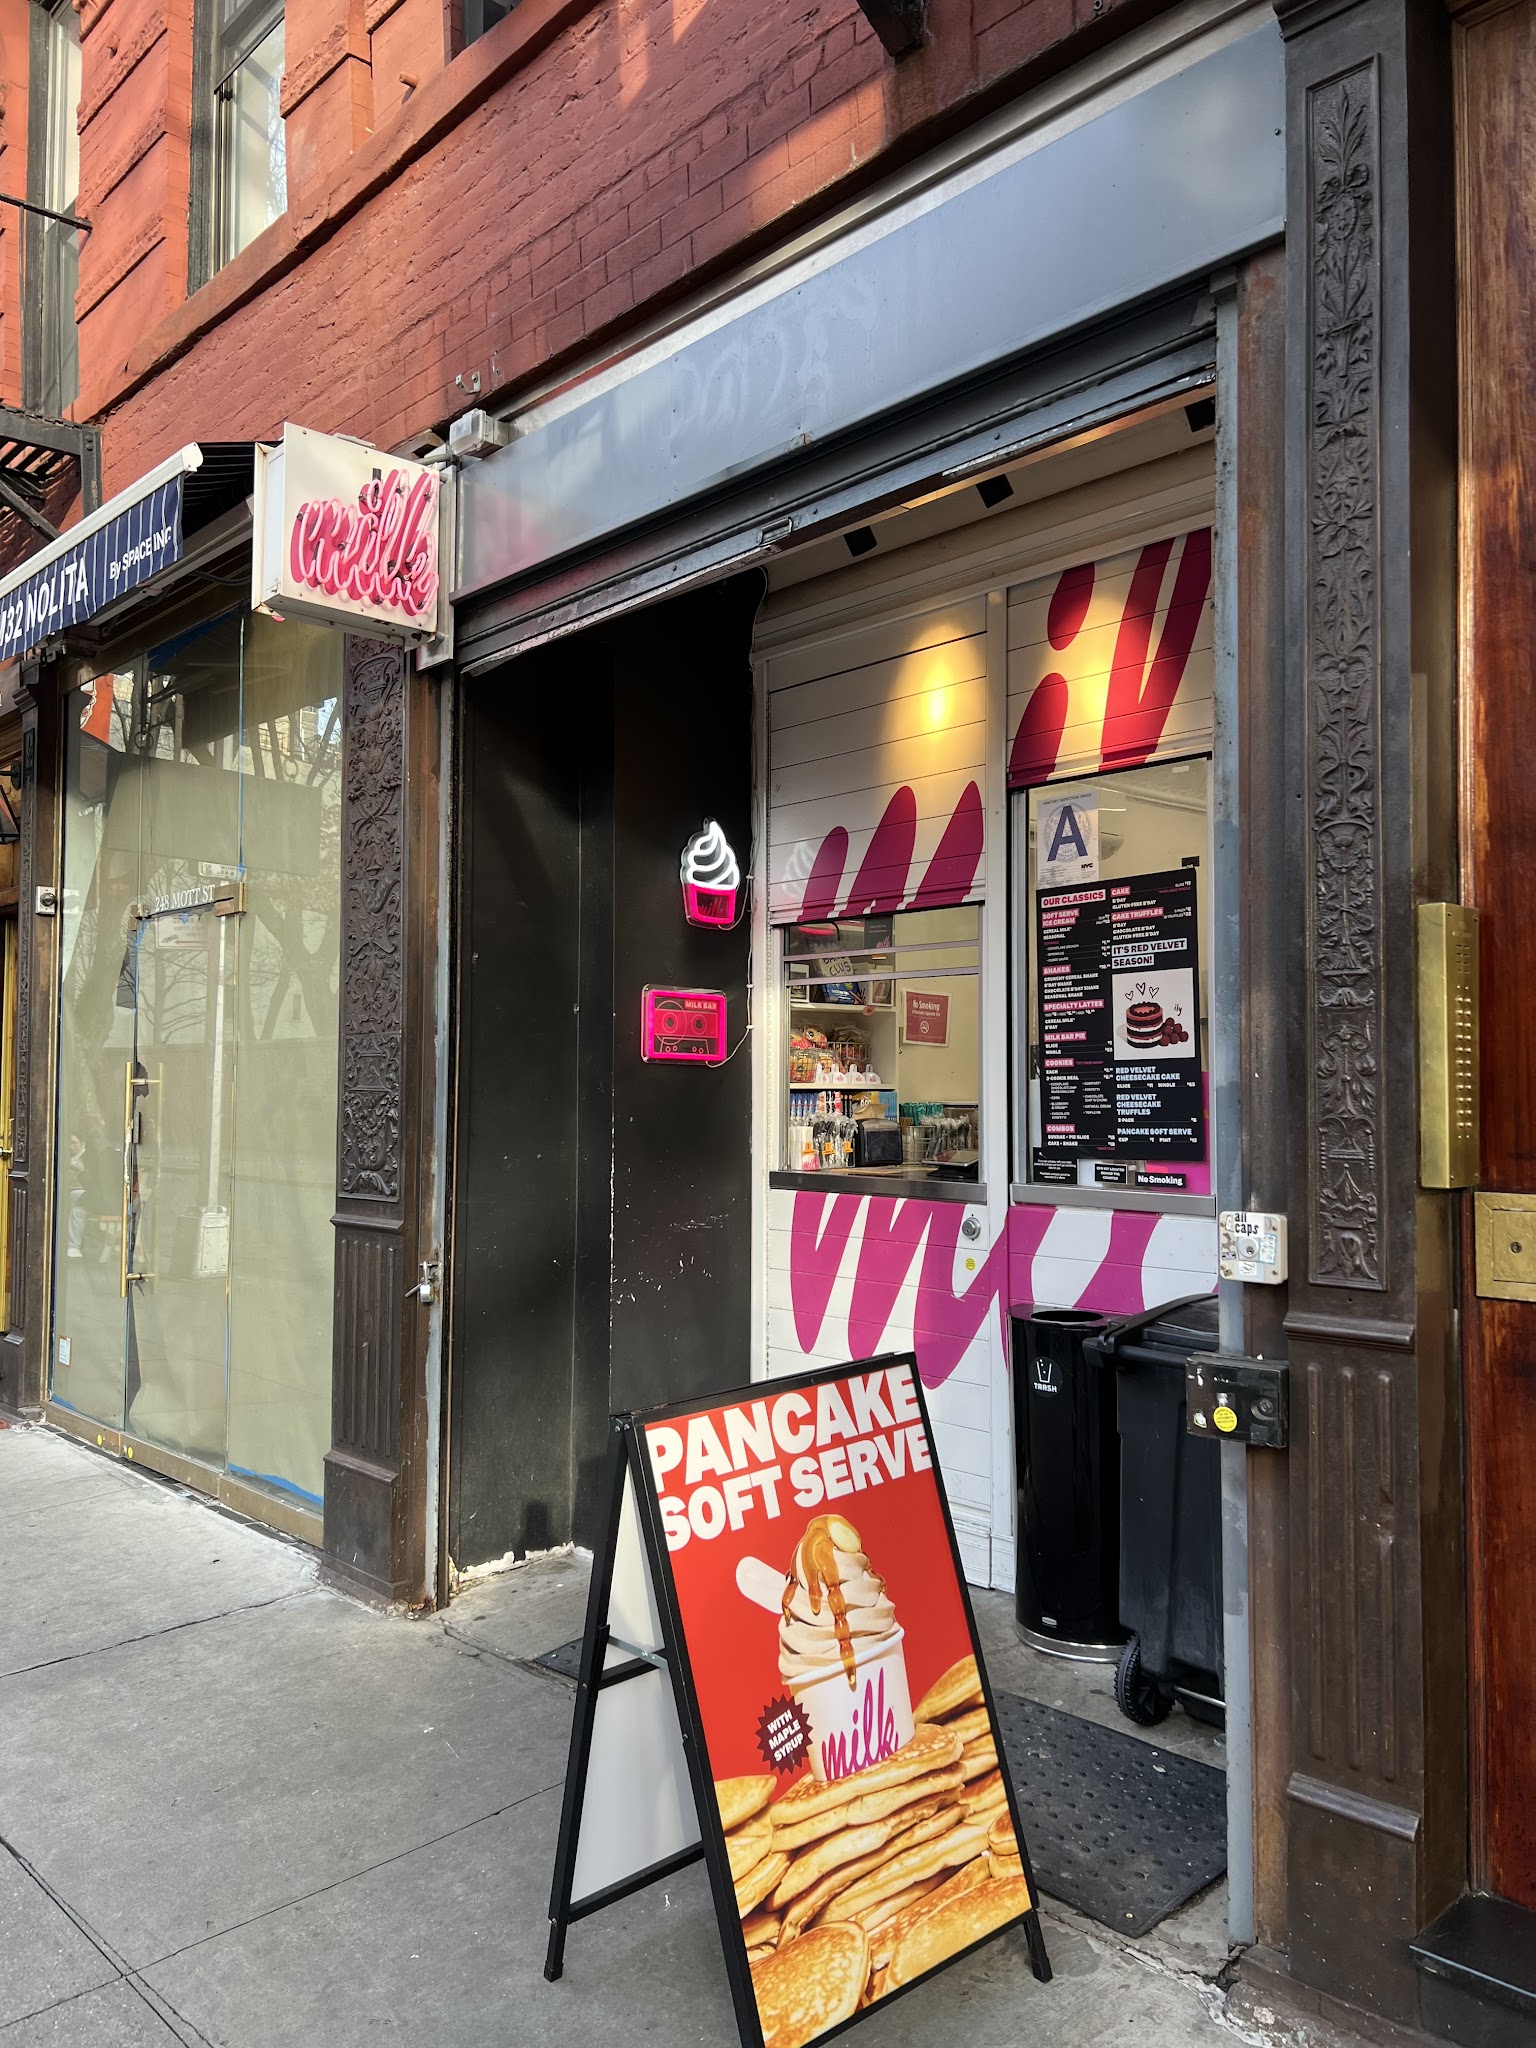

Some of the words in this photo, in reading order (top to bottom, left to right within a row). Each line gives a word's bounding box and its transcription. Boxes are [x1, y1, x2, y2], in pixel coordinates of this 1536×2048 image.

[109, 561, 121, 580] By
[122, 539, 152, 571] SPACE
[153, 526, 172, 552] INC
[26, 557, 89, 632] NOLITA
[1047, 805, 1088, 862] A
[155, 894, 169, 912] 248
[172, 887, 200, 909] MOTT
[202, 884, 215, 902] ST
[1043, 897, 1060, 906] OUR
[1061, 891, 1103, 904] CLASSICS
[1112, 888, 1129, 896] CAKE
[1043, 912, 1058, 920] SOFT
[1059, 909, 1079, 917] SERVE
[1130, 908, 1163, 917] TRUFFLES
[1114, 946, 1130, 954] IT'S
[1131, 943, 1149, 952] RED
[1150, 940, 1185, 950] VELVET
[1114, 955, 1153, 966] SEASON!
[830, 961, 851, 976] CLUB
[1043, 966, 1070, 974] SHAKES
[685, 1001, 701, 1009] MILK
[912, 1000, 918, 1009] No
[919, 1001, 940, 1012] Smoking
[1044, 1003, 1078, 1011] SPECIALTY
[1079, 1000, 1103, 1008] LATTES
[1137, 1175, 1148, 1183] No
[1149, 1175, 1183, 1186] Smoking
[1234, 1223, 1259, 1236] caps
[1033, 1382, 1057, 1393] TRASH
[645, 1364, 922, 1493] PANCAKE
[658, 1464, 782, 1552] SOFT
[789, 1423, 932, 1508] SERVE
[767, 1709, 793, 1734] WITH
[822, 1667, 899, 1781] milk
[768, 1719, 800, 1750] MAPLE
[773, 1733, 804, 1762] SYRUP
